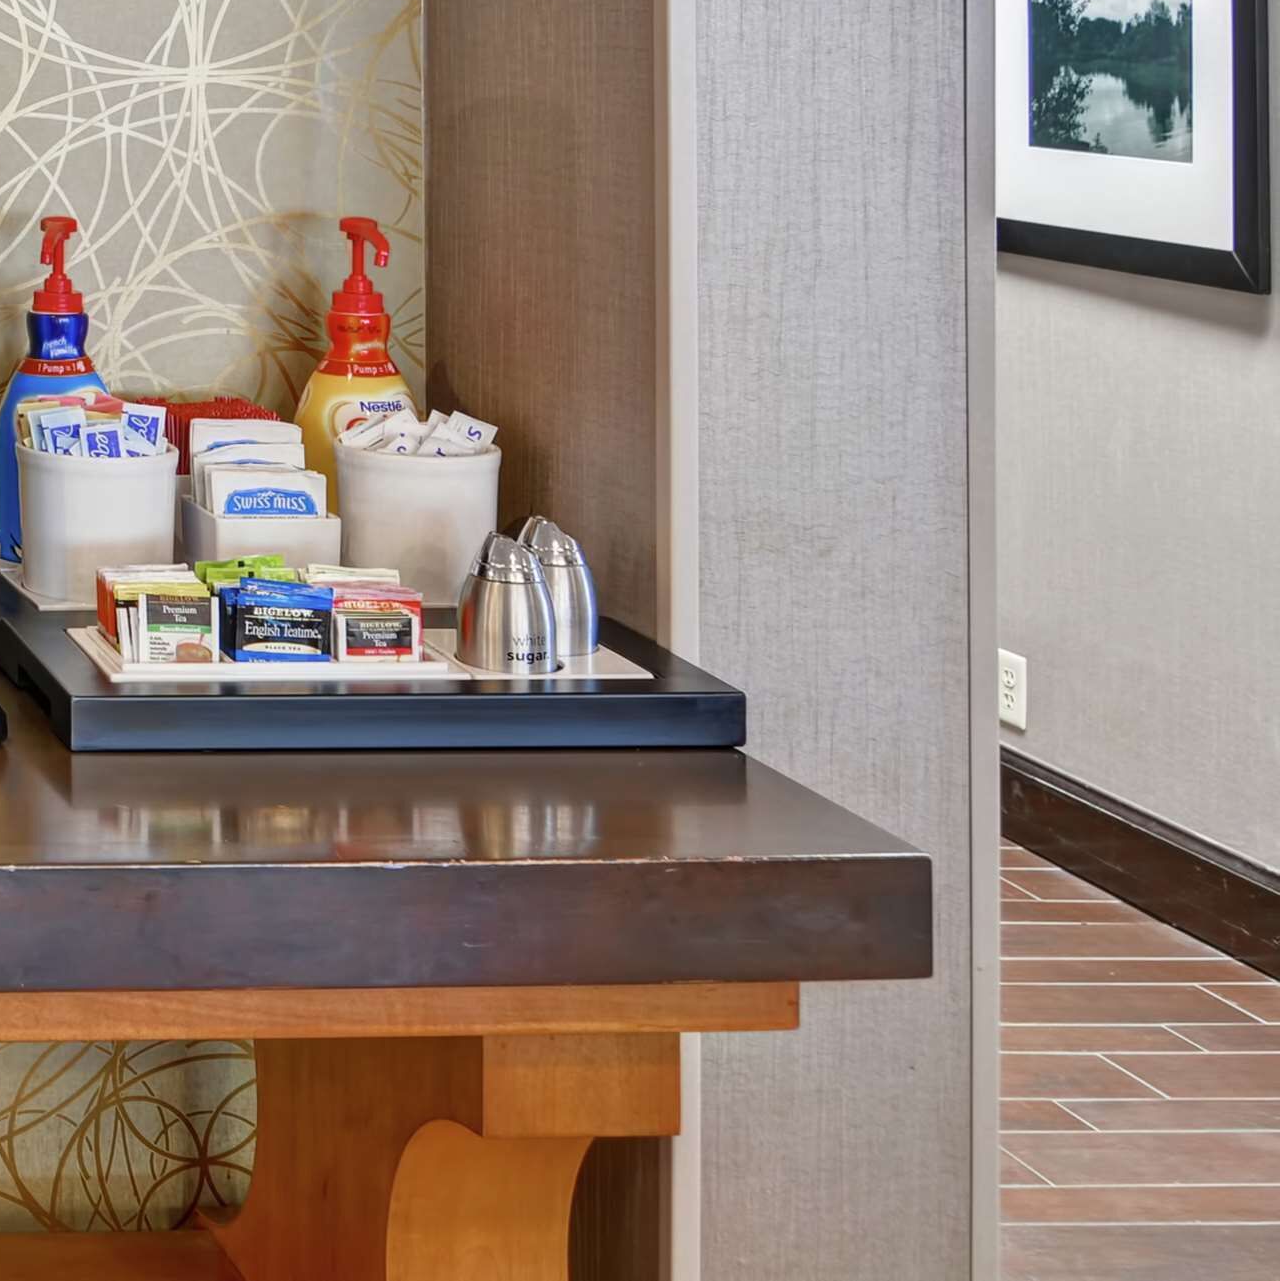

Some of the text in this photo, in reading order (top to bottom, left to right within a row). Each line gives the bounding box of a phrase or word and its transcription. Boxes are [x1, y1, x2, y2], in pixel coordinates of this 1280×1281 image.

[42, 363, 65, 375] Pump
[353, 363, 378, 376] Pump
[162, 605, 198, 614] Premium
[174, 614, 187, 623] Tea
[244, 620, 281, 639] English
[362, 631, 398, 640] Premium
[513, 633, 546, 646] white
